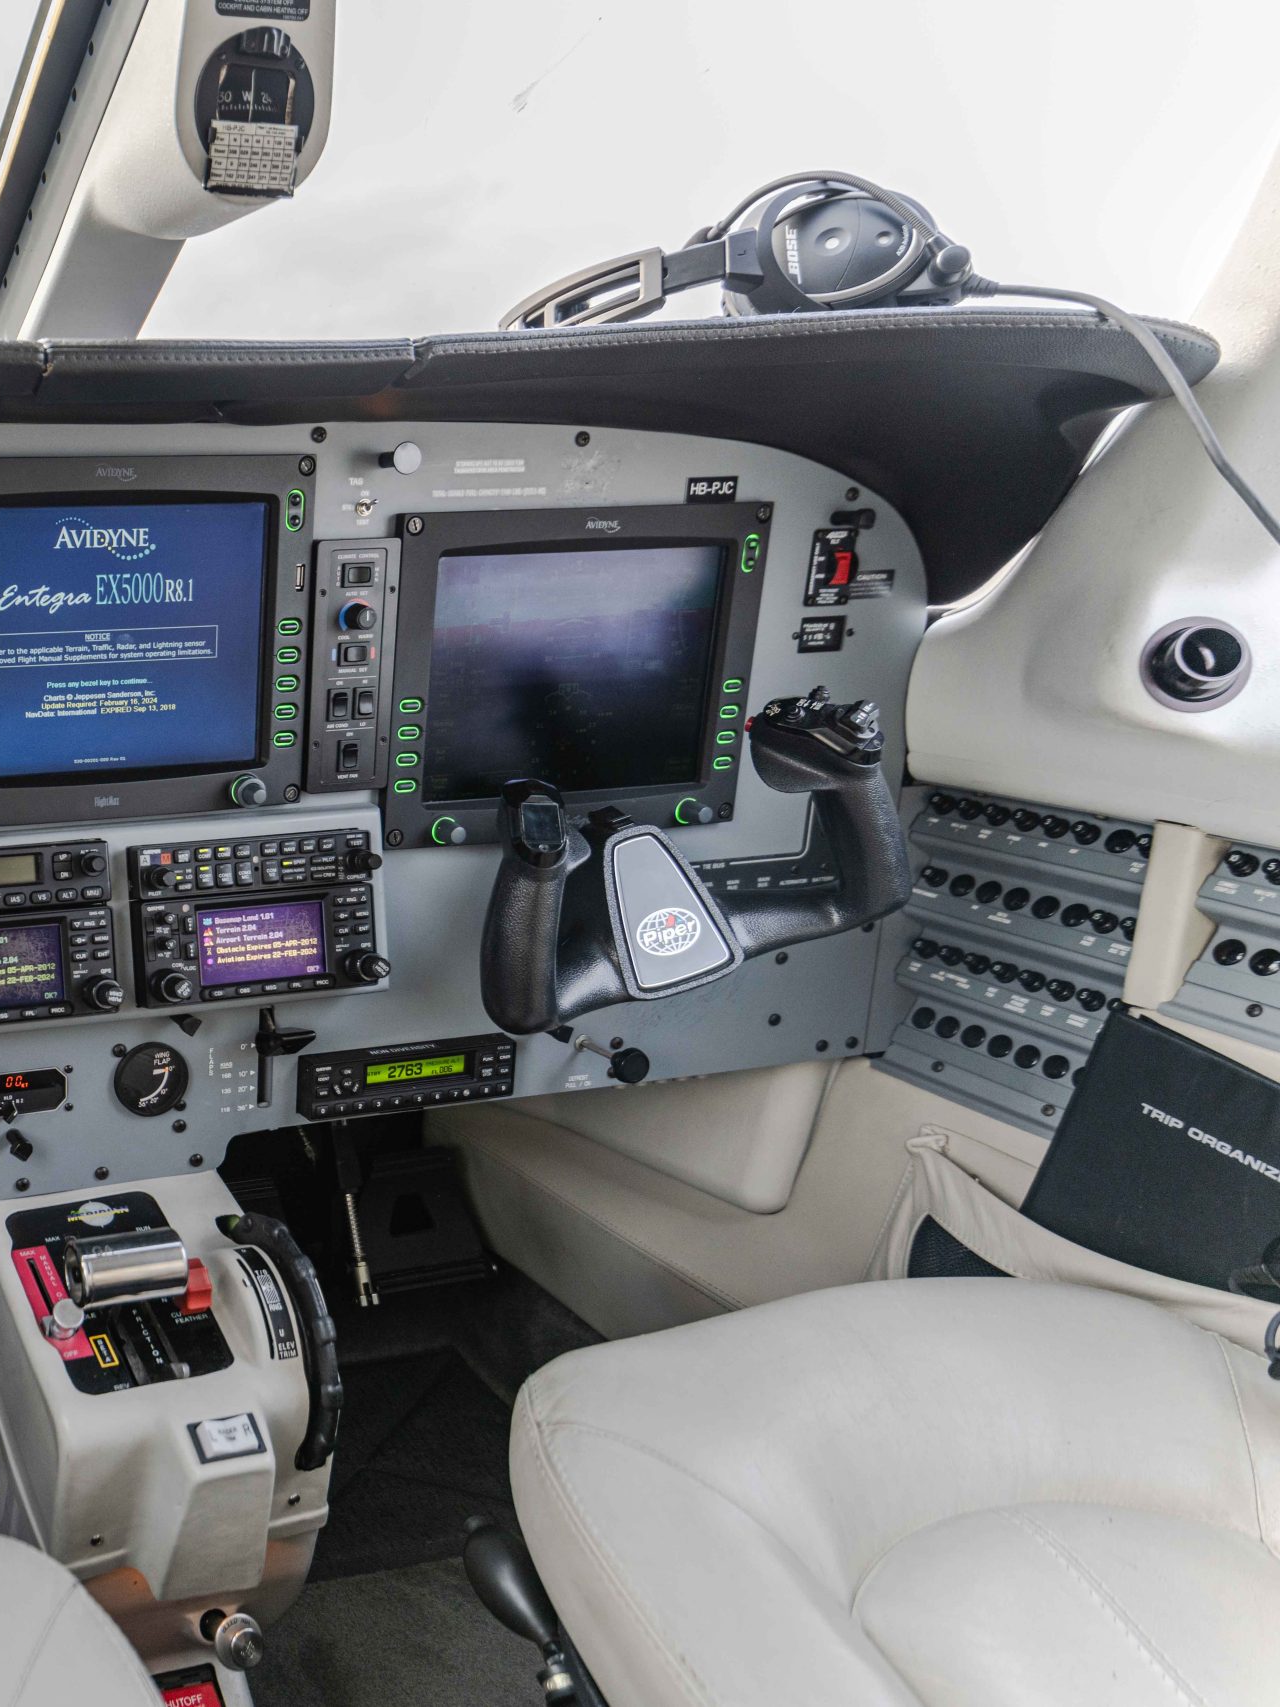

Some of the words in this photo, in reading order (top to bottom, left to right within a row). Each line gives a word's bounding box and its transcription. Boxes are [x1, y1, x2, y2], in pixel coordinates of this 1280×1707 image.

[785, 225, 802, 284] BOSE
[690, 481, 734, 495] HB-PJC
[585, 520, 619, 529] AVIDYNE
[54, 526, 149, 548] AVIDYNE
[96, 573, 163, 604] EX5000
[165, 579, 193, 602] R8.1
[85, 633, 110, 641] NOTICE
[18, 656, 36, 664] Flight
[64, 653, 107, 662] Supplements
[145, 650, 176, 658] operating
[30, 646, 63, 655] applicable
[74, 692, 105, 700] Jeppesen
[42, 702, 65, 710] Update
[643, 920, 696, 946] Piper
[217, 946, 245, 954] Obstacle
[247, 943, 271, 951] Expires
[273, 938, 317, 948] 05-APR-2012
[217, 956, 245, 964] Aviation
[246, 953, 271, 961] Expires
[273, 948, 317, 958] 22-FEB-2024
[7, 963, 56, 973] 05-APR-2012
[7, 973, 55, 984] 22-FEB-2024
[154, 1058, 170, 1066] FLAP
[388, 1063, 423, 1078] 2763
[1140, 1102, 1184, 1129] TRIP
[1187, 1127, 1280, 1183] ORGANIZ
[67, 1205, 129, 1222] MERIDIAN
[175, 1313, 209, 1324] FEATHER
[132, 1309, 164, 1365] FRICTION
[97, 1339, 111, 1363] BETA
[278, 1341, 295, 1350] ELEV
[279, 1350, 297, 1359] TRIM
